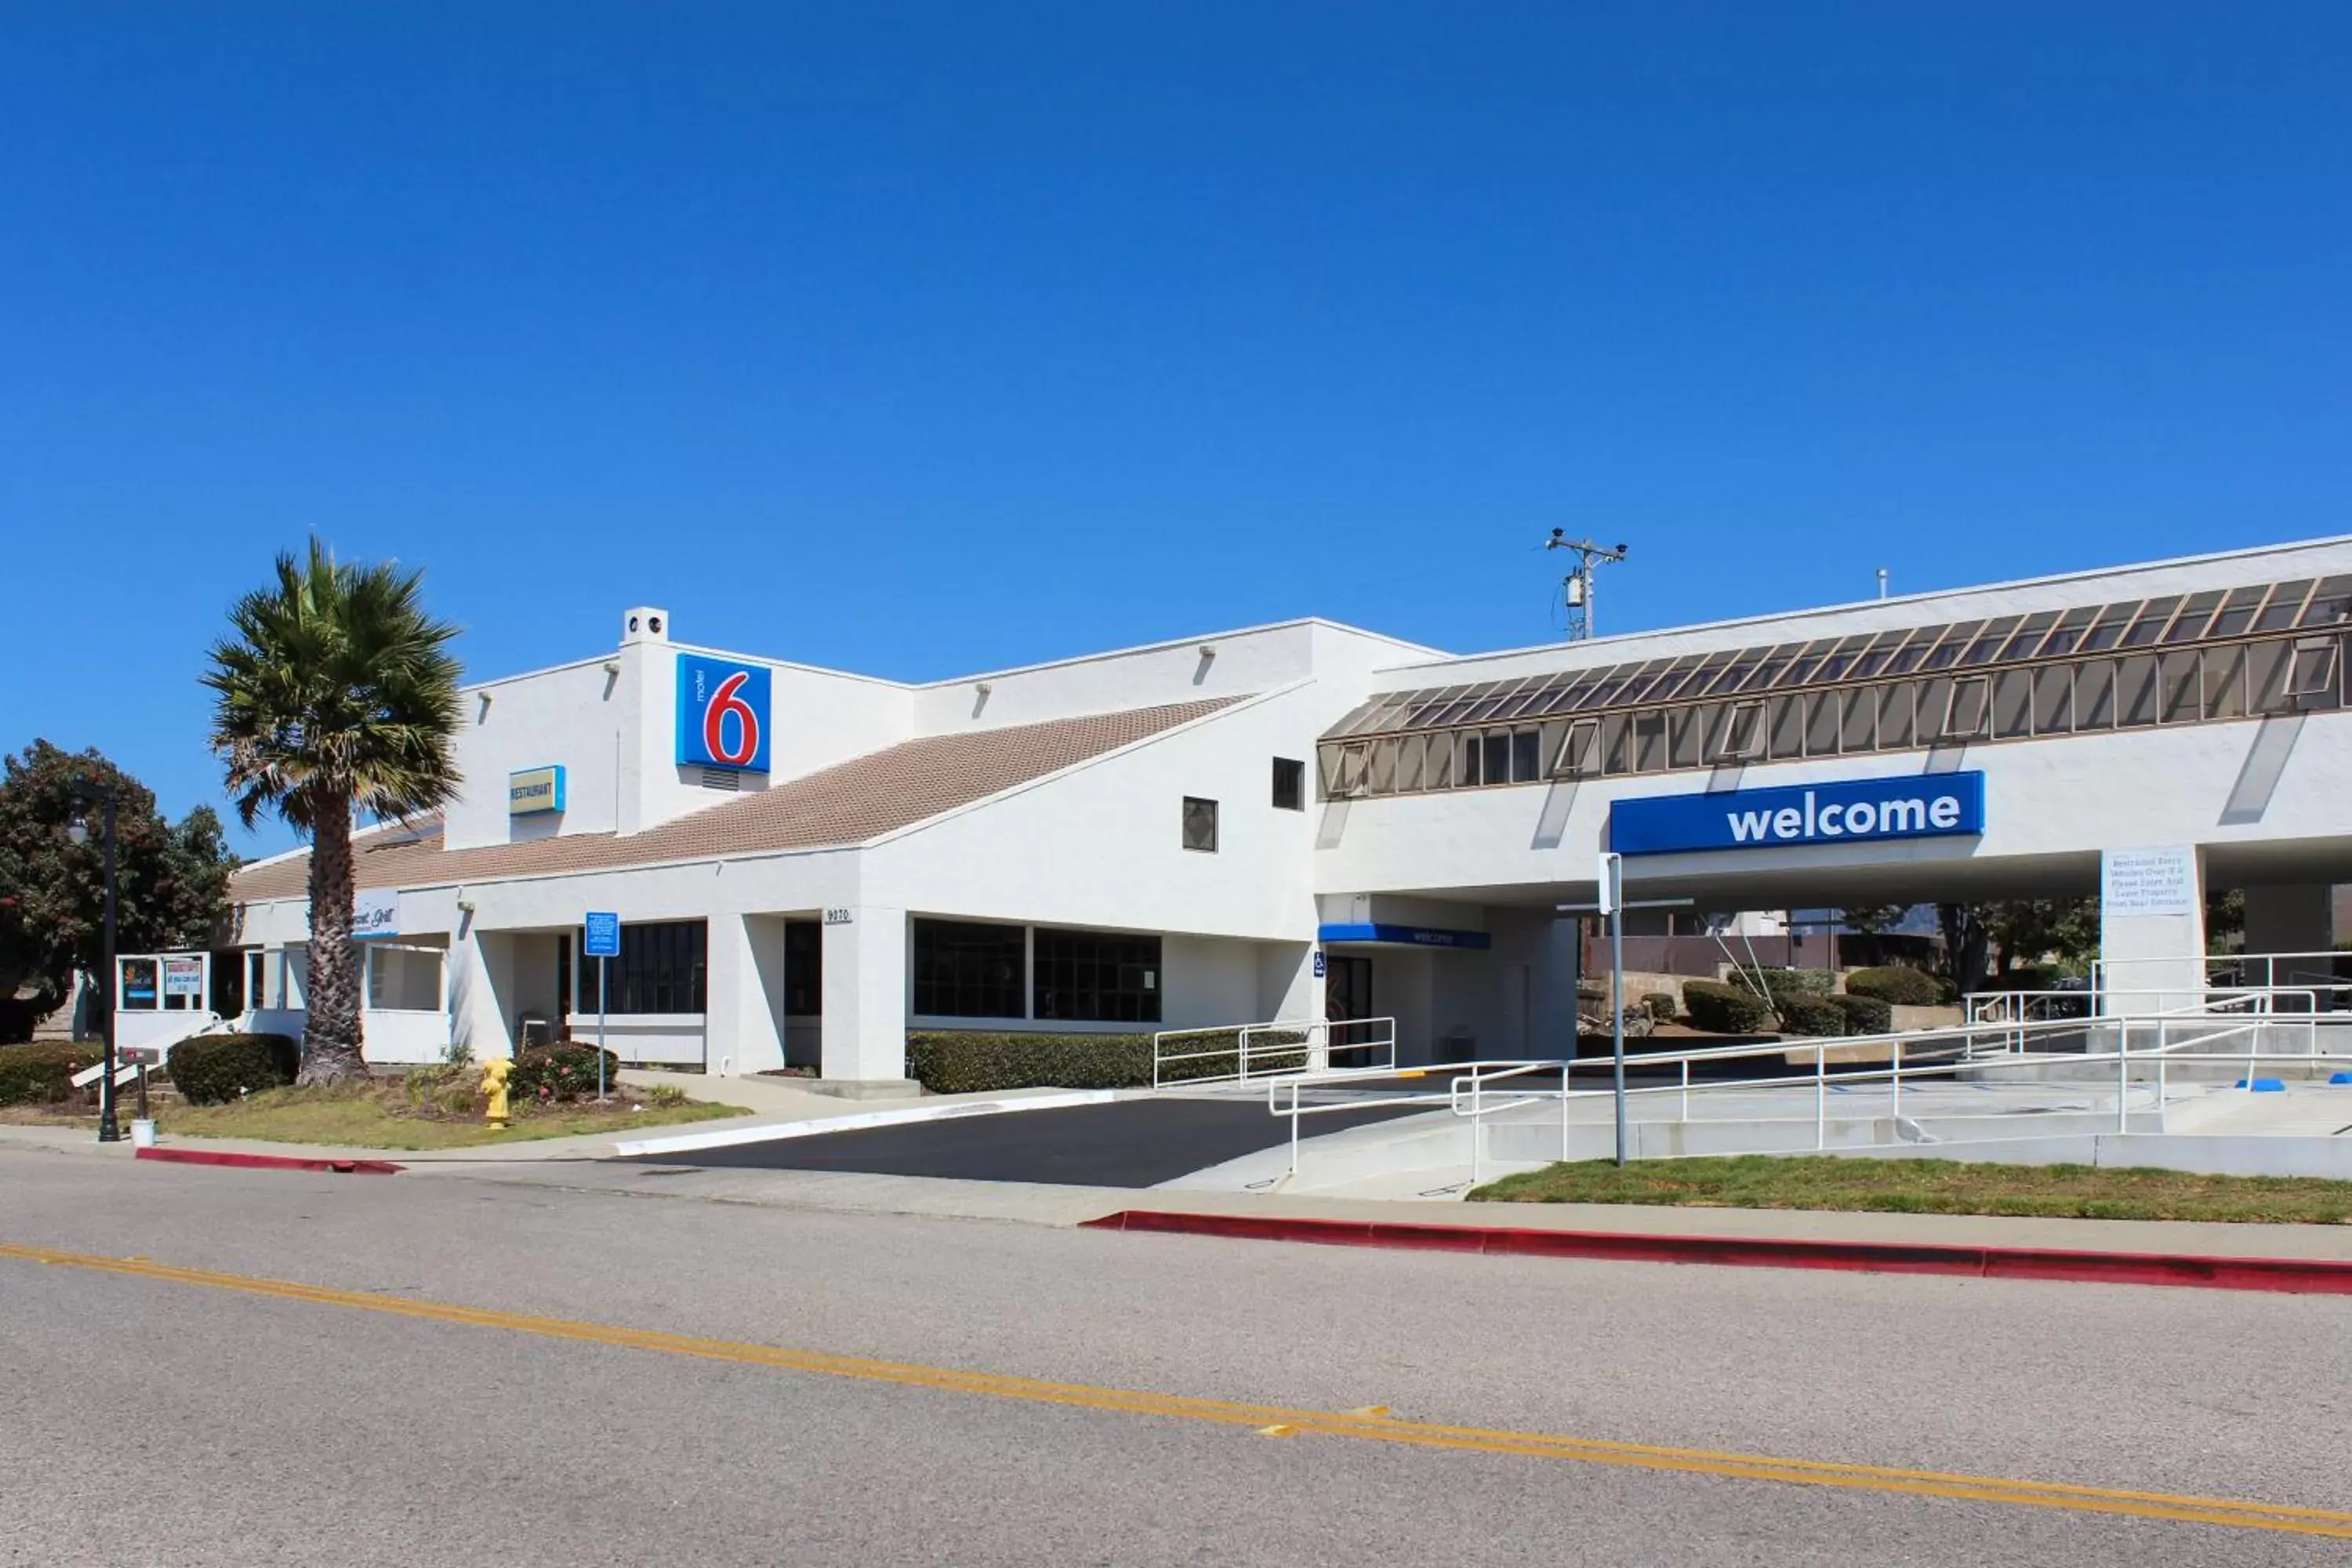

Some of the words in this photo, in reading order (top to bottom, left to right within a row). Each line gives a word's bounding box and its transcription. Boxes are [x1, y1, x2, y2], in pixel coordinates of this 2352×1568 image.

[695, 670, 705, 702] motel
[703, 670, 759, 766] 6
[510, 782, 552, 800] RESTAURANT
[1726, 791, 1961, 841] welcome
